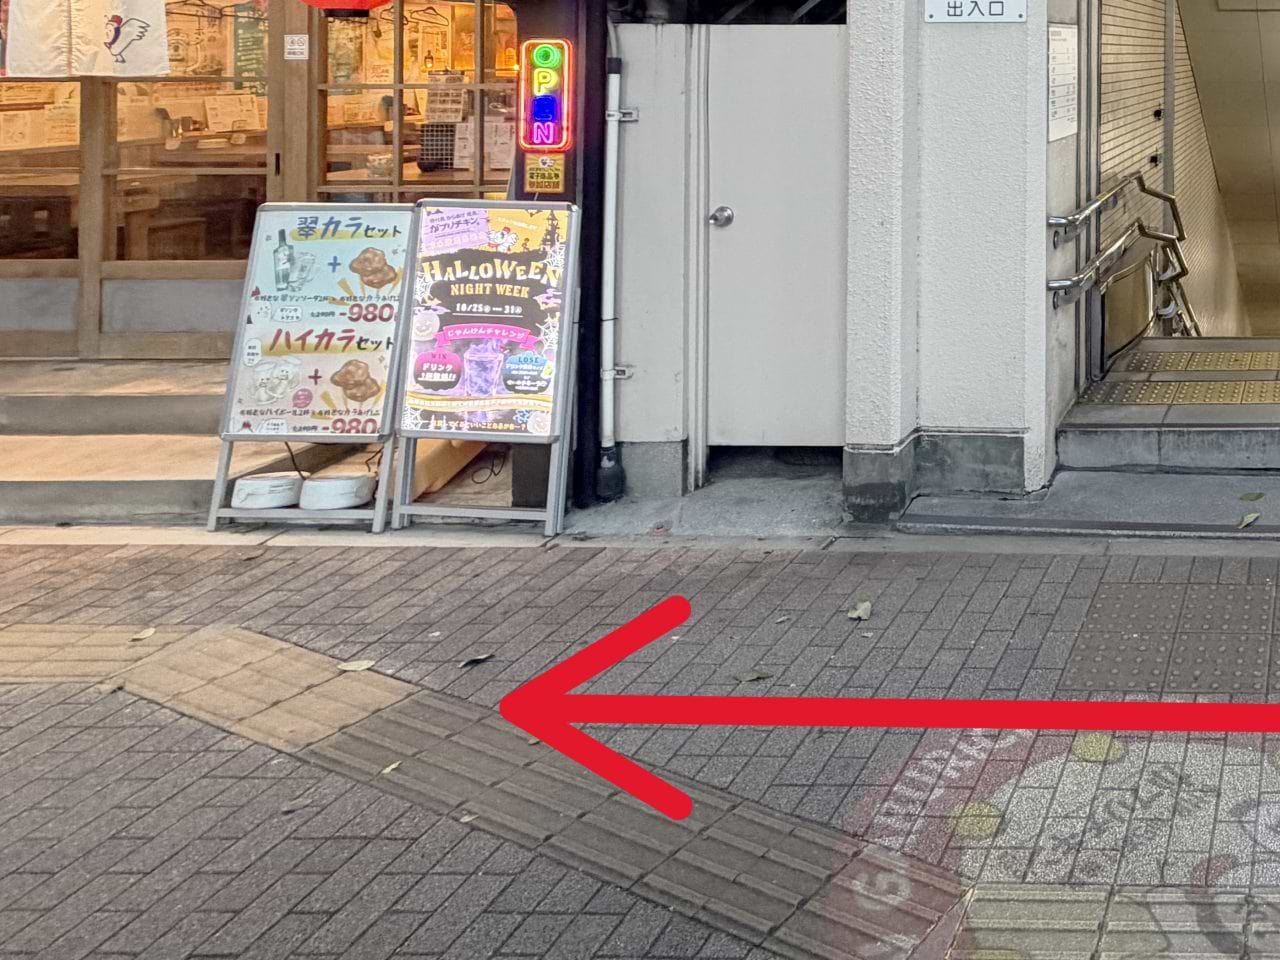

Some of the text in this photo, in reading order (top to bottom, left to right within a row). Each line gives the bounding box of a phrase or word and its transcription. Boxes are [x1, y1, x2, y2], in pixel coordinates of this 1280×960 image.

[947, 1, 1004, 17] 出入口
[532, 43, 561, 145] OPEN
[422, 258, 560, 287] HALLOWEEN
[450, 283, 530, 298] NIGHT WEEK
